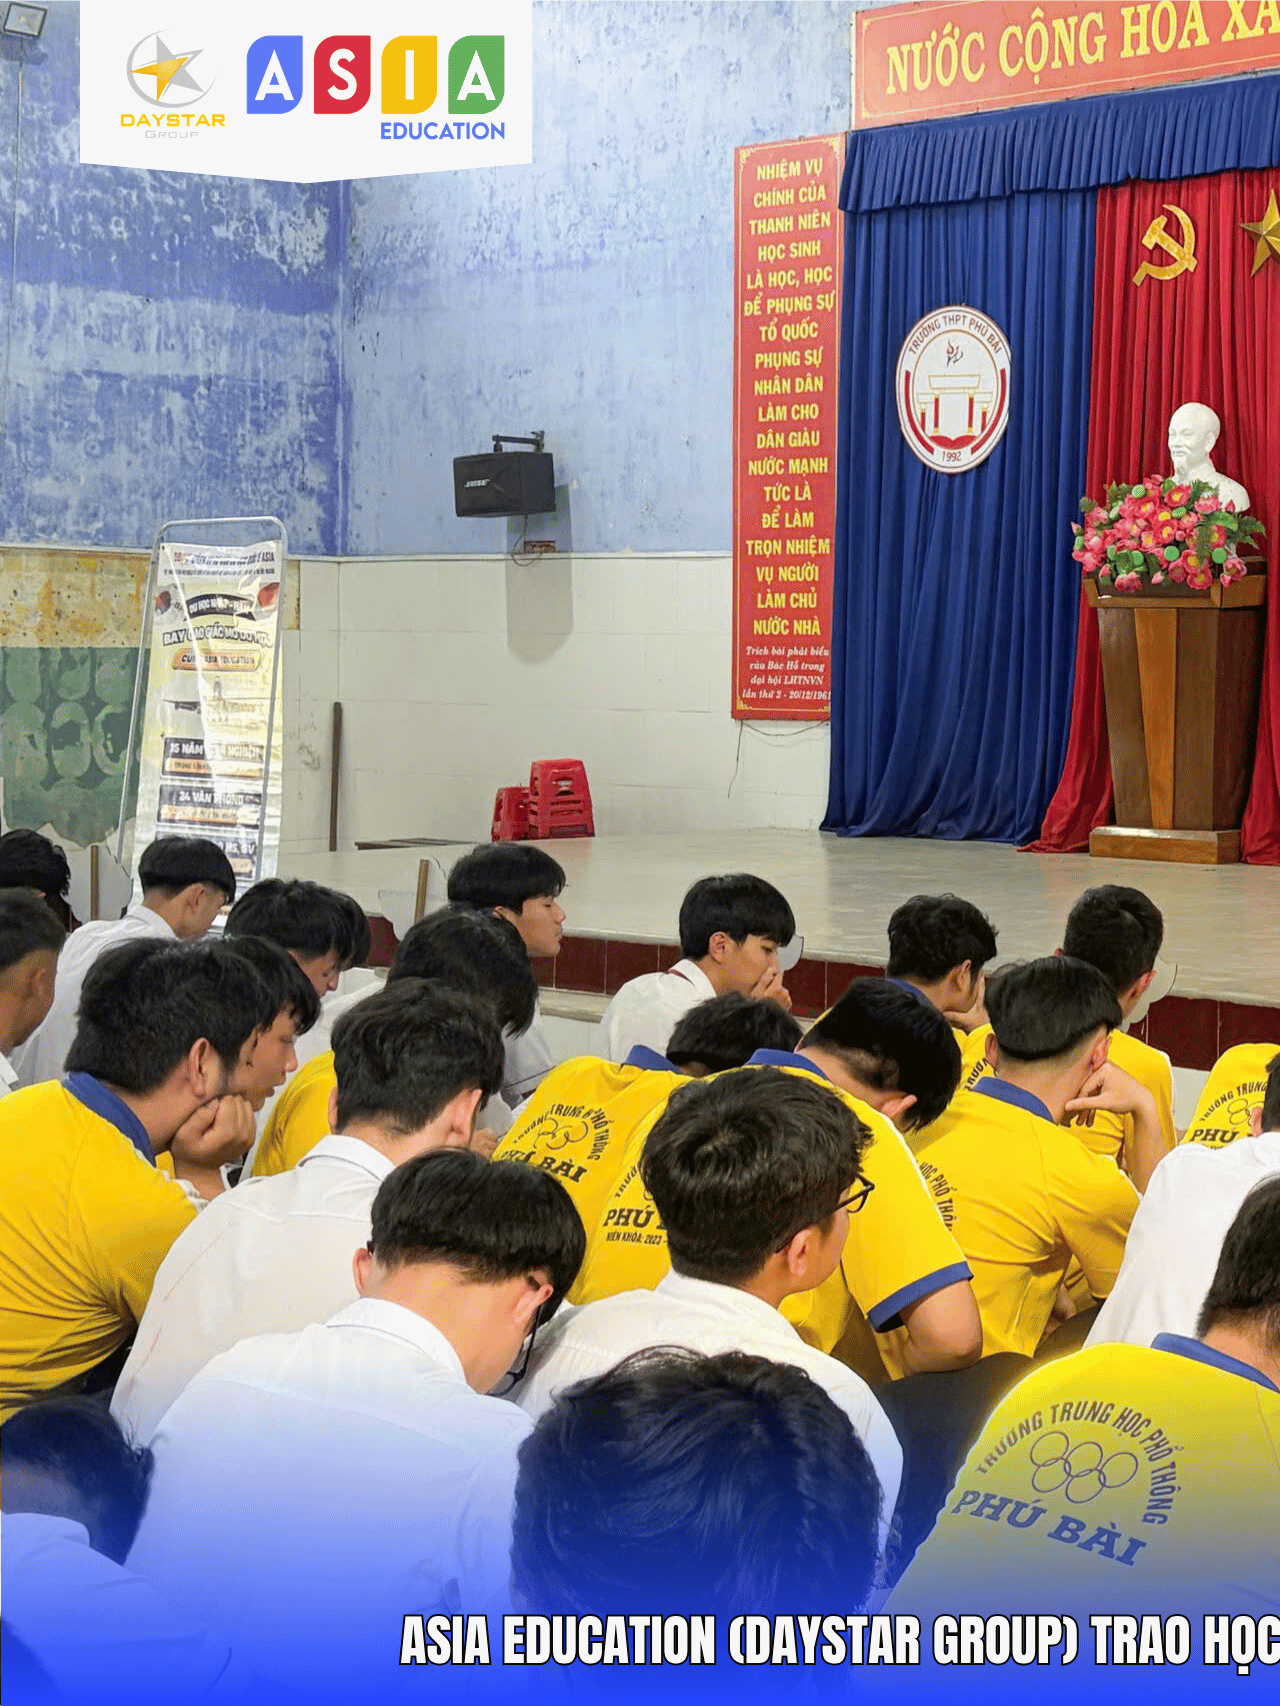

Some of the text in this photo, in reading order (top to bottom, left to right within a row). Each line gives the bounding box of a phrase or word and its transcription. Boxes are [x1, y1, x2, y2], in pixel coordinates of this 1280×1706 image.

[886, 6, 1107, 94] NƯỚC CỘNG
[756, 157, 824, 181] NHIỆM VỤ
[753, 180, 827, 209] CHÍNH CỦA
[749, 209, 831, 236] THANH NIÊN
[758, 240, 821, 264] HỌC SINH
[746, 265, 833, 290] LÀ HỌC, HỌC
[743, 289, 837, 317] ĐỂ PHỤNG SỰ
[759, 316, 819, 342] TỔ QUỐC
[942, 314, 968, 327] THPT
[755, 346, 824, 371] PHỤNG SỰ
[754, 373, 824, 396] NHÂN DÂN
[758, 401, 819, 423] LÀM CHO
[756, 427, 820, 449] DÂN GIÀU
[748, 455, 829, 477] NƯỚC MẠNH
[942, 451, 962, 462] 1992
[763, 480, 812, 502] TỨC LÀ
[762, 504, 814, 529] ĐỂ LÀM
[745, 535, 831, 559] TRỌN NHIỆM
[756, 562, 819, 585] VỤ NGƯỜI
[757, 586, 817, 609] LÀM CHỦ
[753, 615, 821, 636] NƯỚC NHÀ
[179, 790, 191, 802] 24
[602, 1204, 656, 1229] PHÚ
[1050, 1400, 1184, 1526] TRUNG HỌC PHỔ THÔNG
[951, 1490, 1147, 1567] PHÚ BÀI
